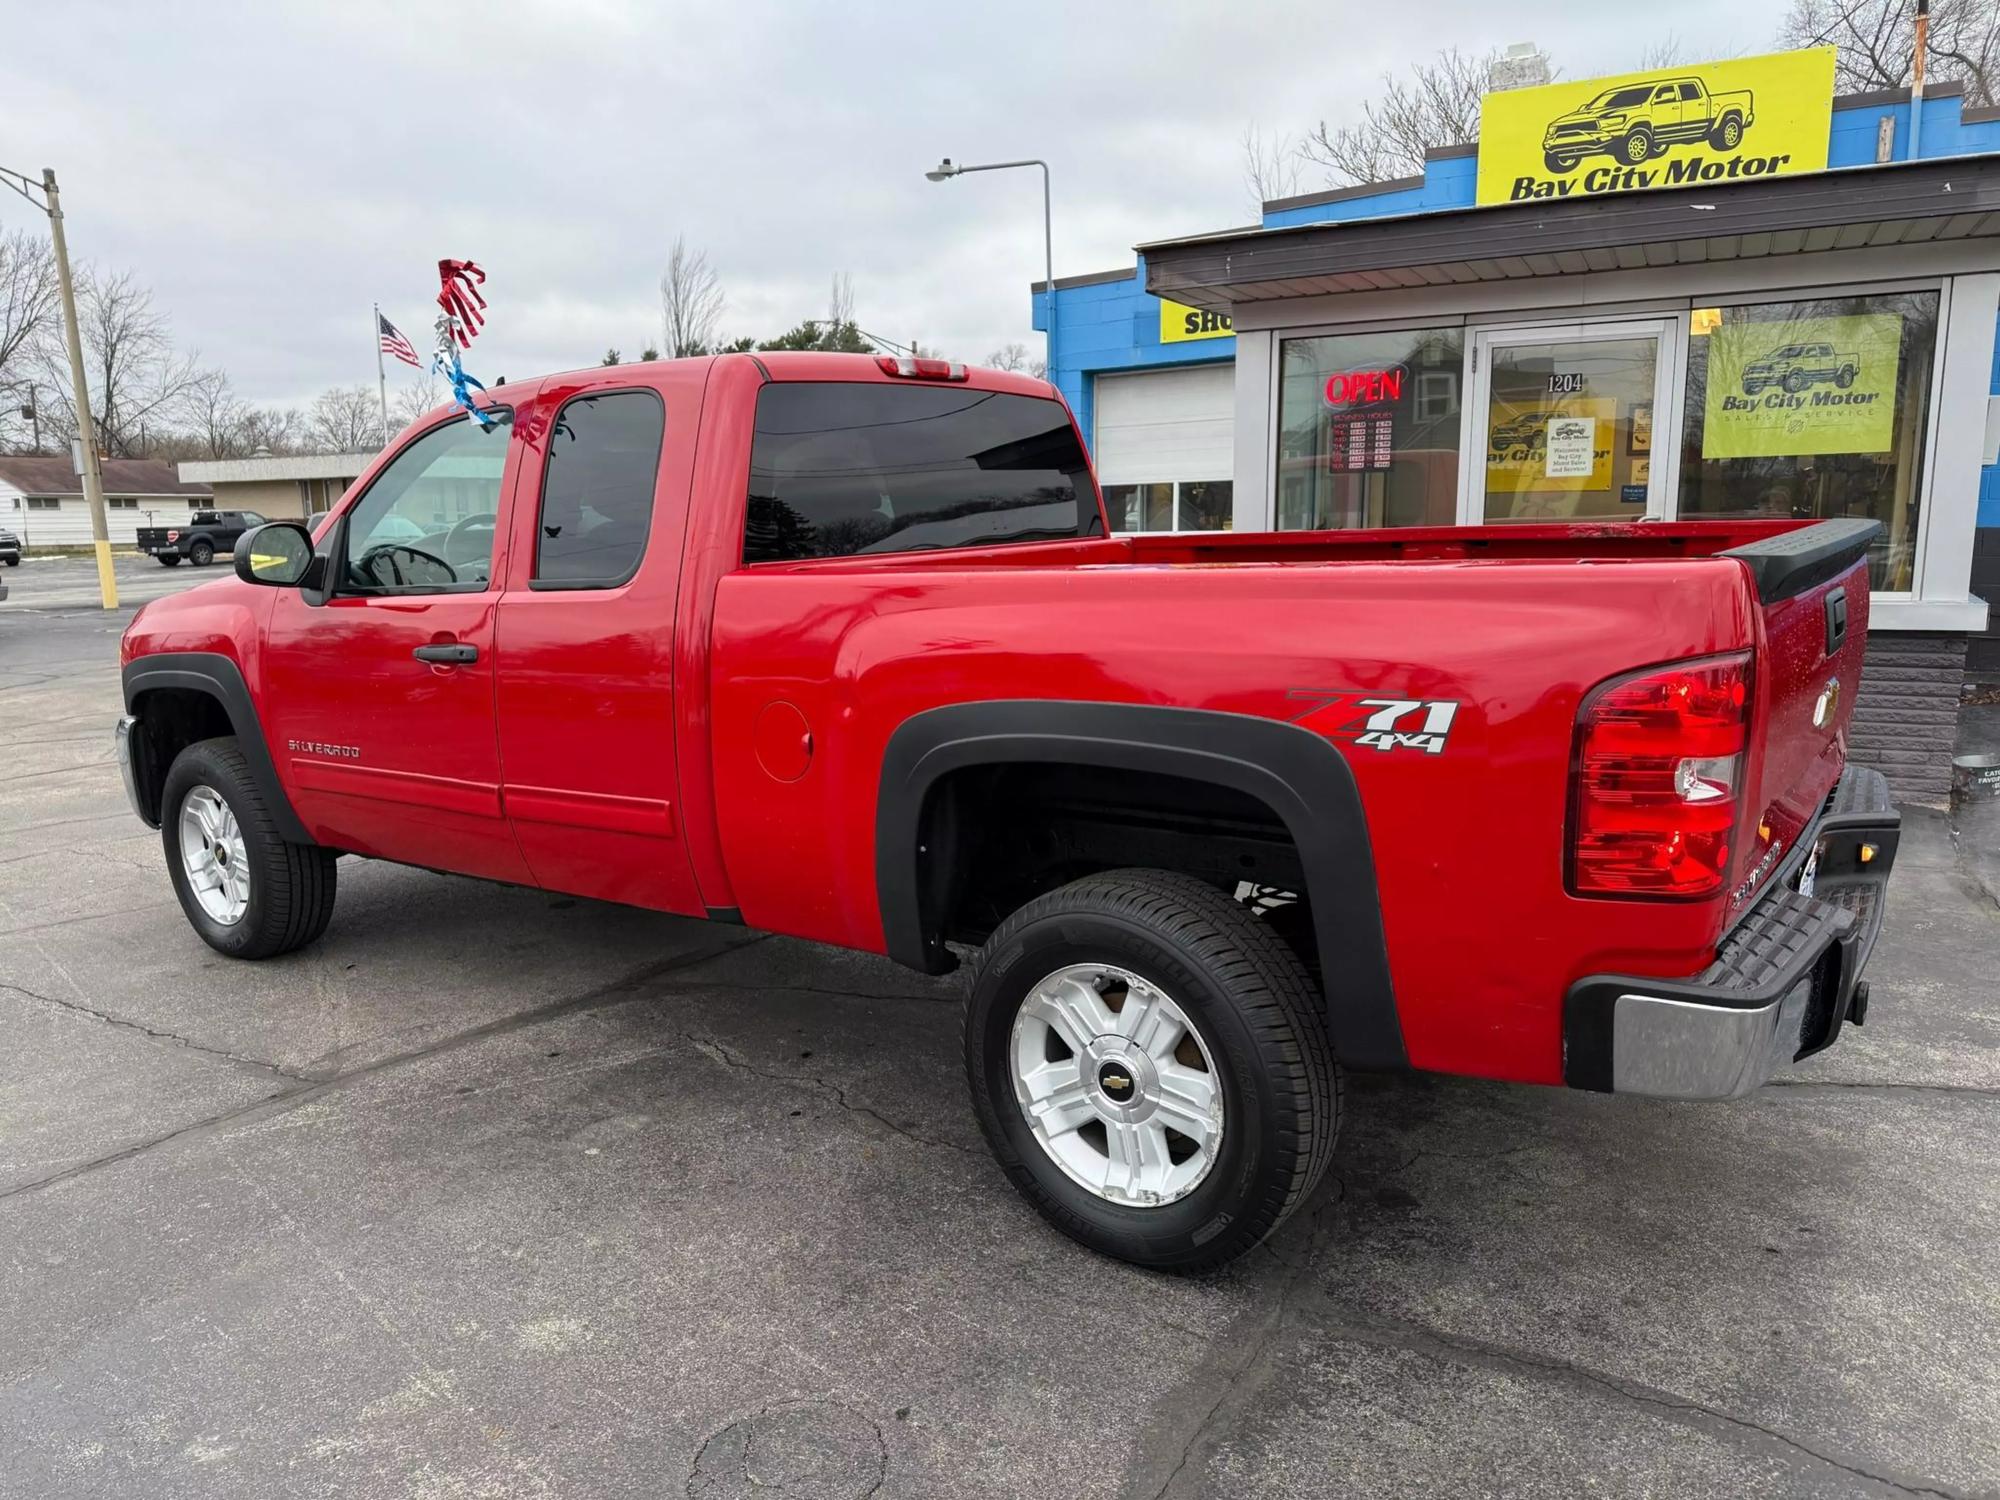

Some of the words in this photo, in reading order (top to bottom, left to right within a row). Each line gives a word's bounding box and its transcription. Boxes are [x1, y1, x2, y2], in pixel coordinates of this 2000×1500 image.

[1510, 177, 1577, 201] Bay
[1584, 166, 1660, 193] City
[1664, 154, 1791, 185] Motor
[1325, 369, 1400, 404] OPEN
[1548, 373, 1582, 392] 1204
[1722, 395, 1761, 413] Bay
[1765, 393, 1806, 411] City
[1810, 391, 1879, 407] Motor
[1805, 409, 1874, 418] SERVICE
[1487, 452, 1508, 464] ay
[1511, 449, 1546, 463] City
[288, 739, 360, 758] SILVERADO
